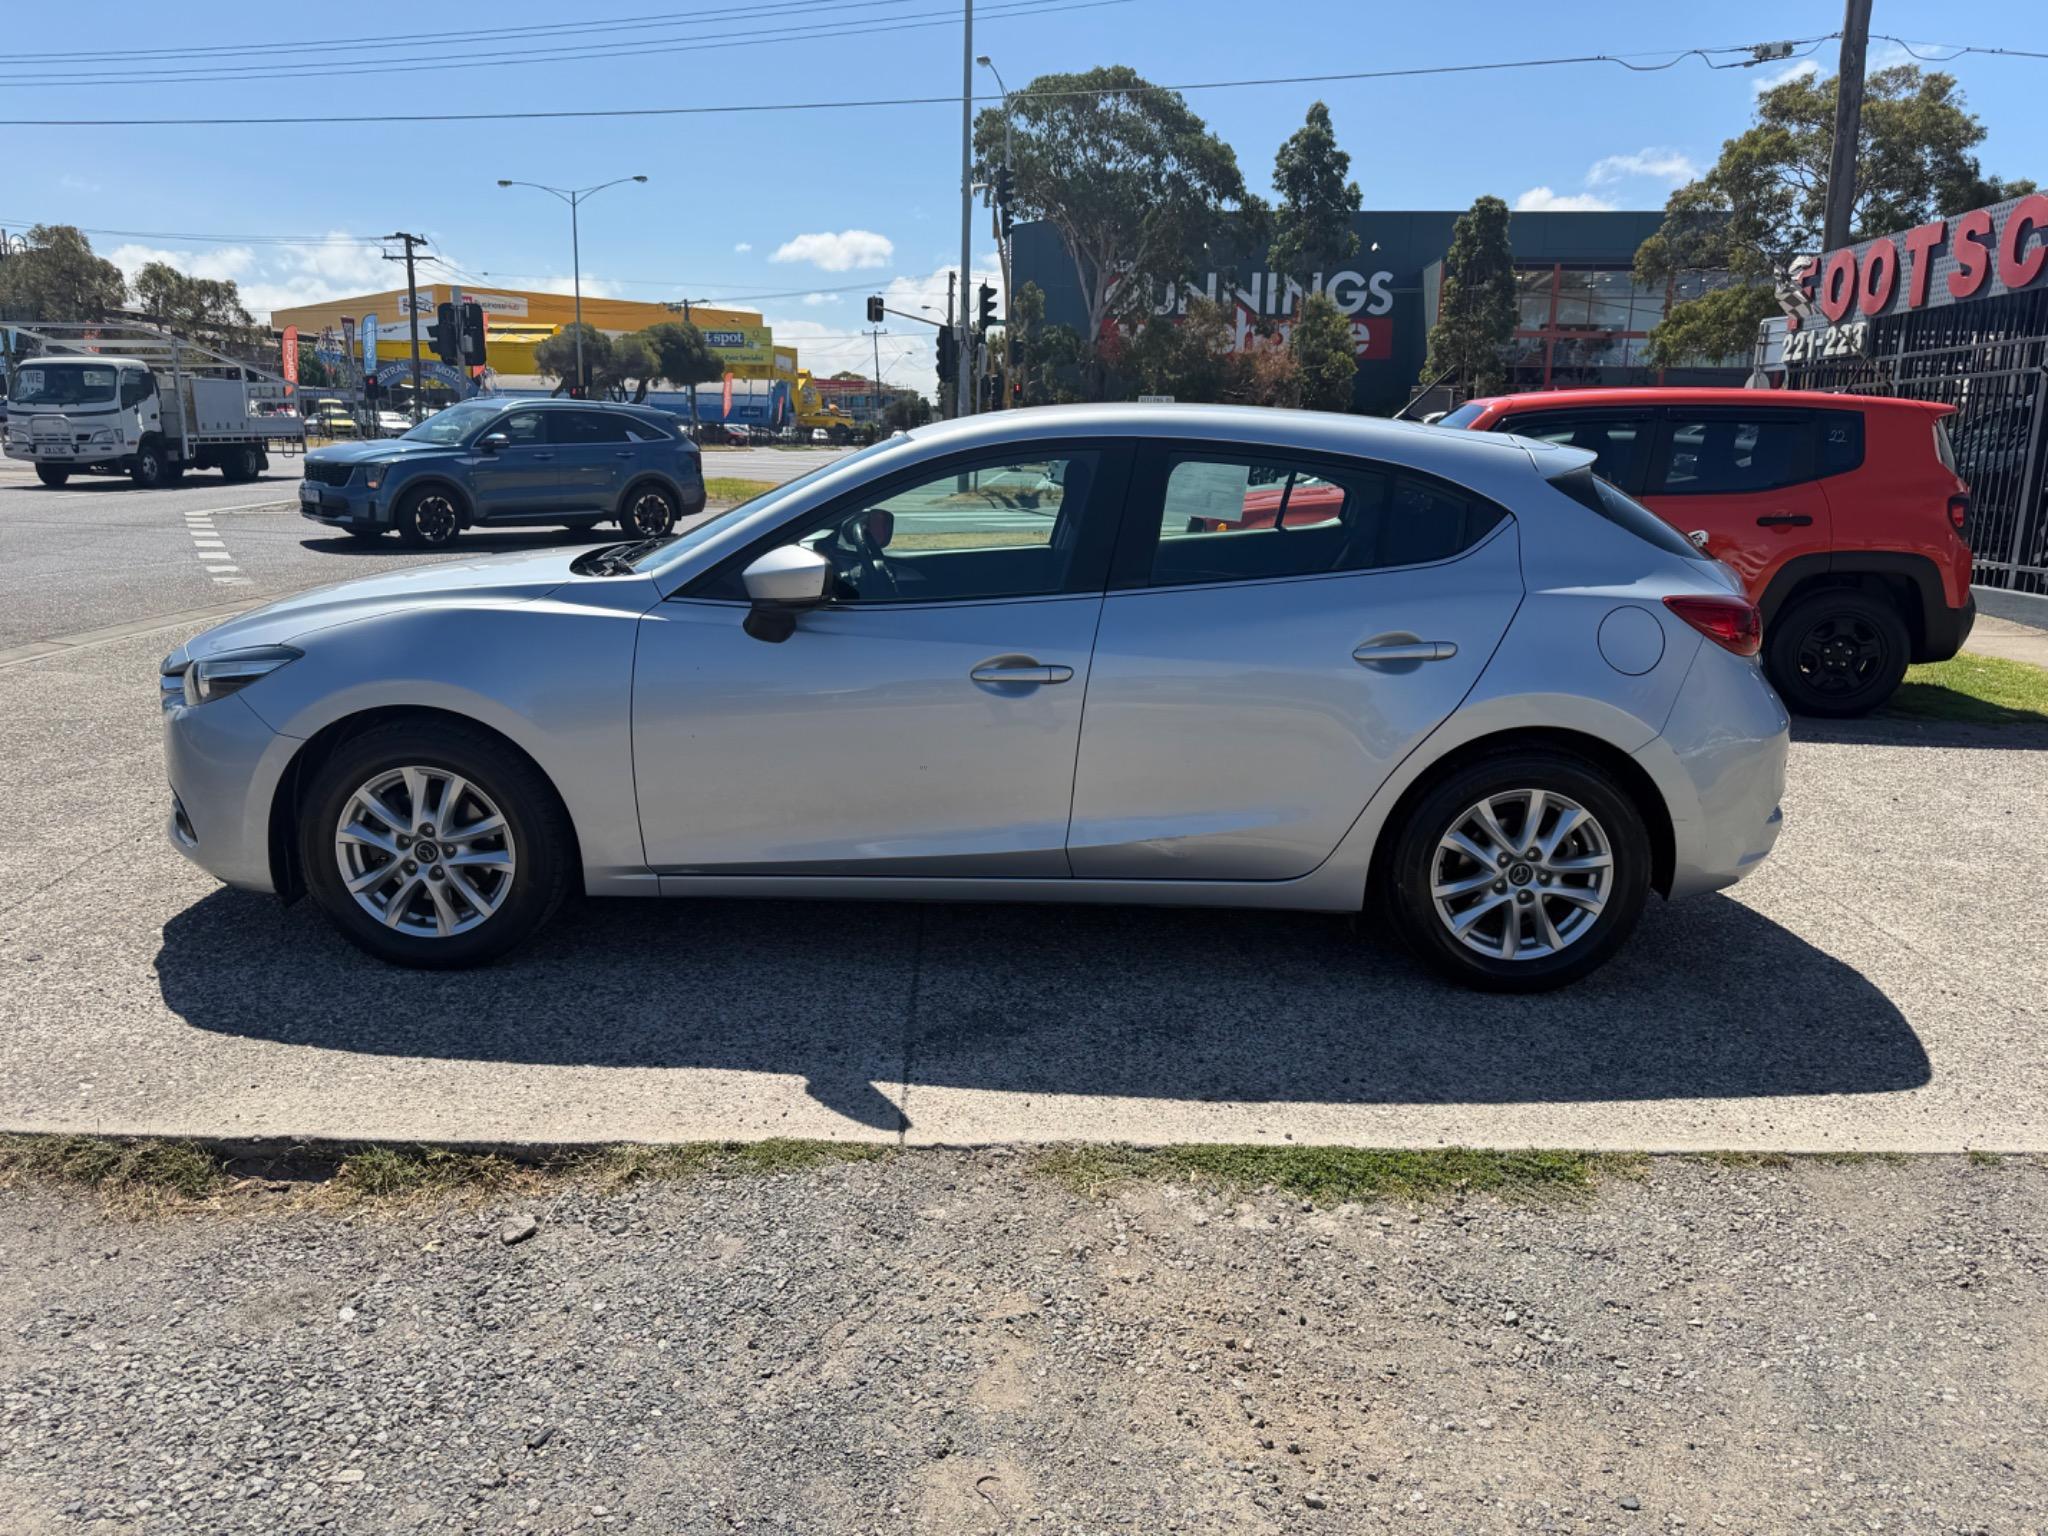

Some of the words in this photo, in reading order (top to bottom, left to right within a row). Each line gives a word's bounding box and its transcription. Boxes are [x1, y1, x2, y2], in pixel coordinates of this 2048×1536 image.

[1780, 322, 1867, 362] 221-223
[376, 363, 409, 385] ENTRAL
[435, 364, 472, 391] MOTOS
[1828, 429, 1849, 443] 22
